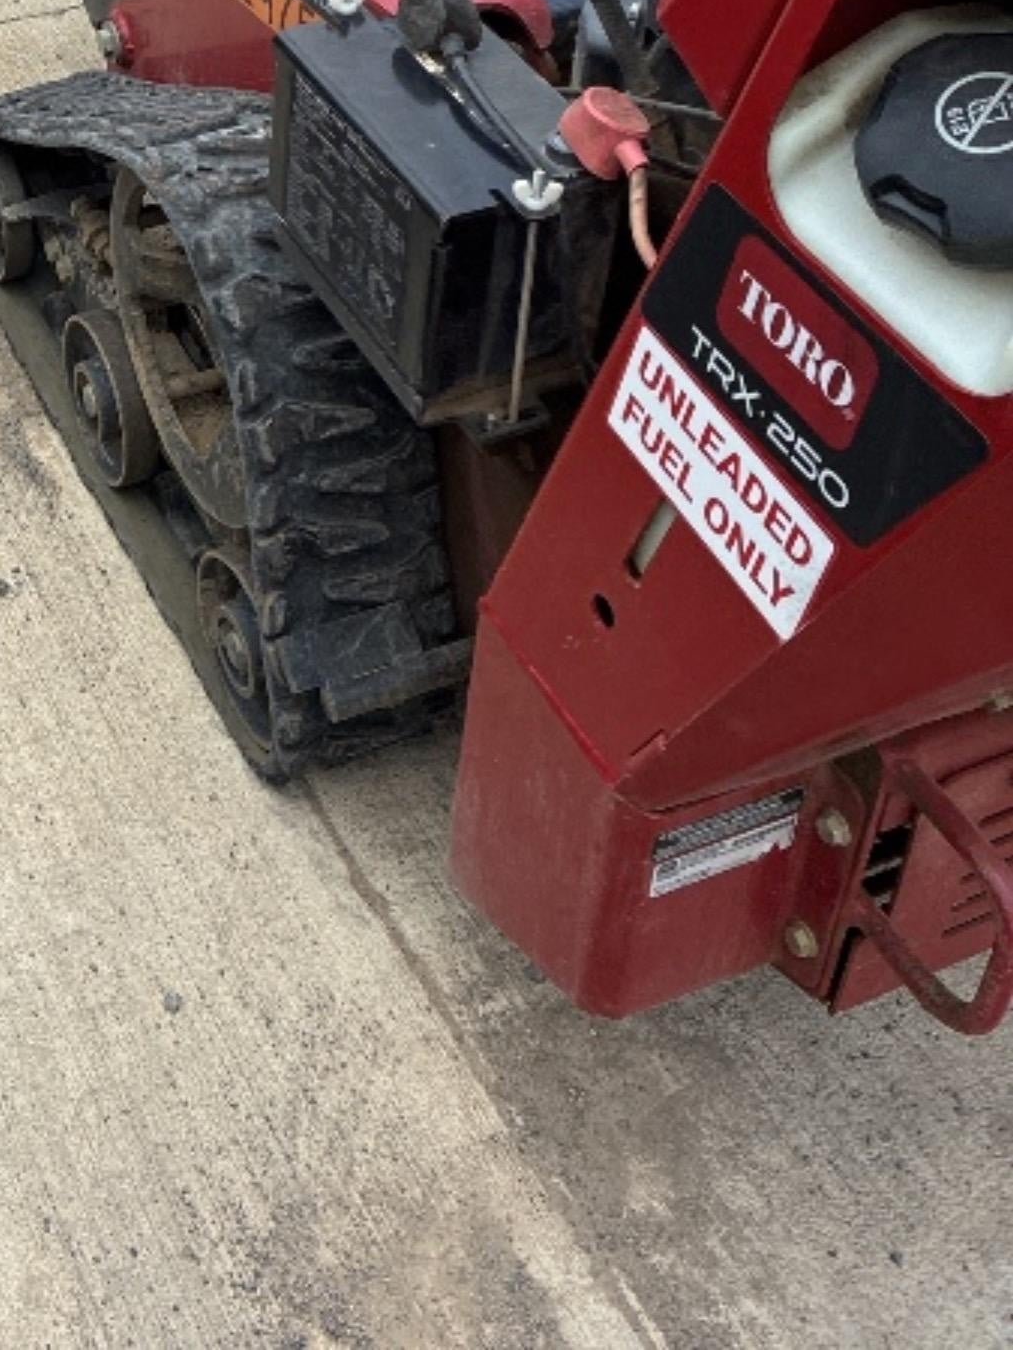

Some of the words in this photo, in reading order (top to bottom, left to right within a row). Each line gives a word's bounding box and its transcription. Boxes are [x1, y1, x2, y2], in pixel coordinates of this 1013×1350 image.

[738, 269, 855, 408] TORO
[622, 393, 693, 503] FUEL
[704, 497, 795, 607] ONLY
[638, 350, 812, 566] UNLEADED
